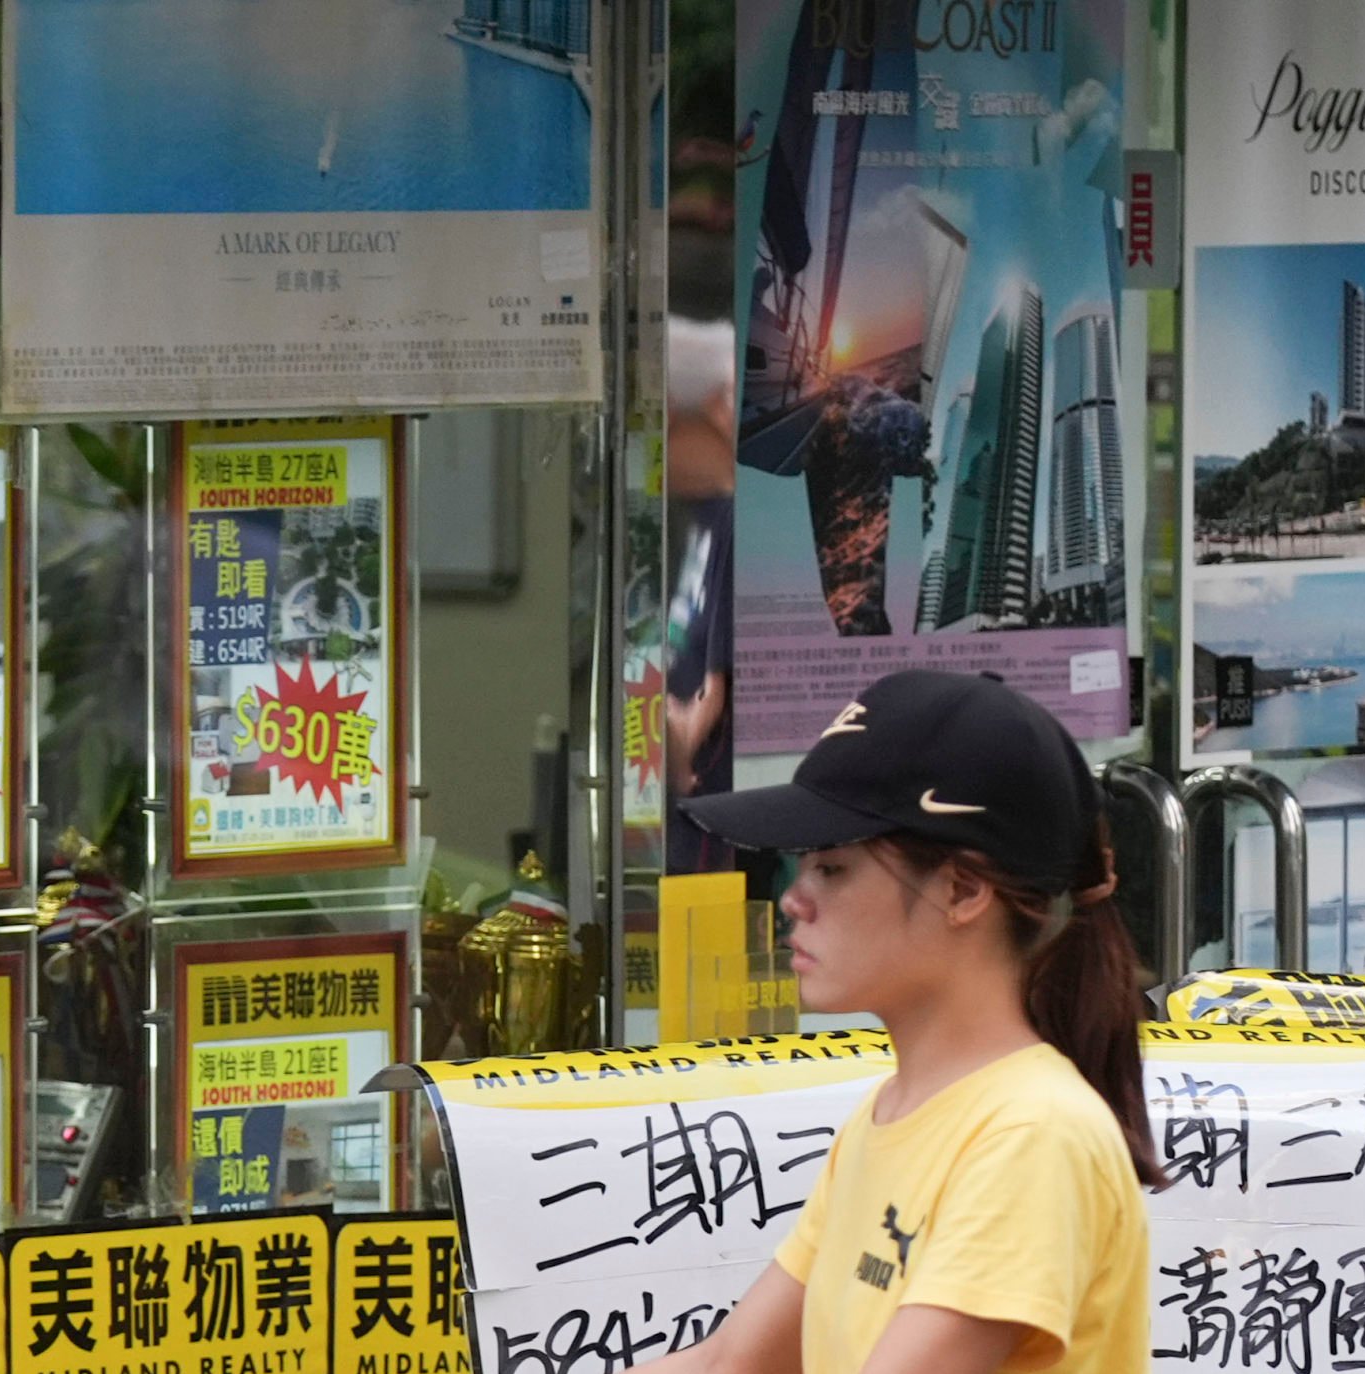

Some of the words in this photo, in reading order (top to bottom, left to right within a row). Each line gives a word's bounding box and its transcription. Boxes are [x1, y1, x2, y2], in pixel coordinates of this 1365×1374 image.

[216, 233, 232, 255] A
[235, 231, 291, 255] MARK
[296, 231, 322, 254] OF
[326, 229, 402, 254] LEGACY
[198, 488, 250, 509] SOUTH
[254, 486, 334, 507] HORIZONS
[234, 686, 378, 787] $630萬
[250, 967, 380, 1022] 美聯物業
[474, 1056, 697, 1090] MIDLAND
[730, 1042, 893, 1069] REALTY
[201, 1088, 253, 1107] SOUTH
[256, 1077, 336, 1101] HORIZONS
[28, 1232, 313, 1358] 美聯物業
